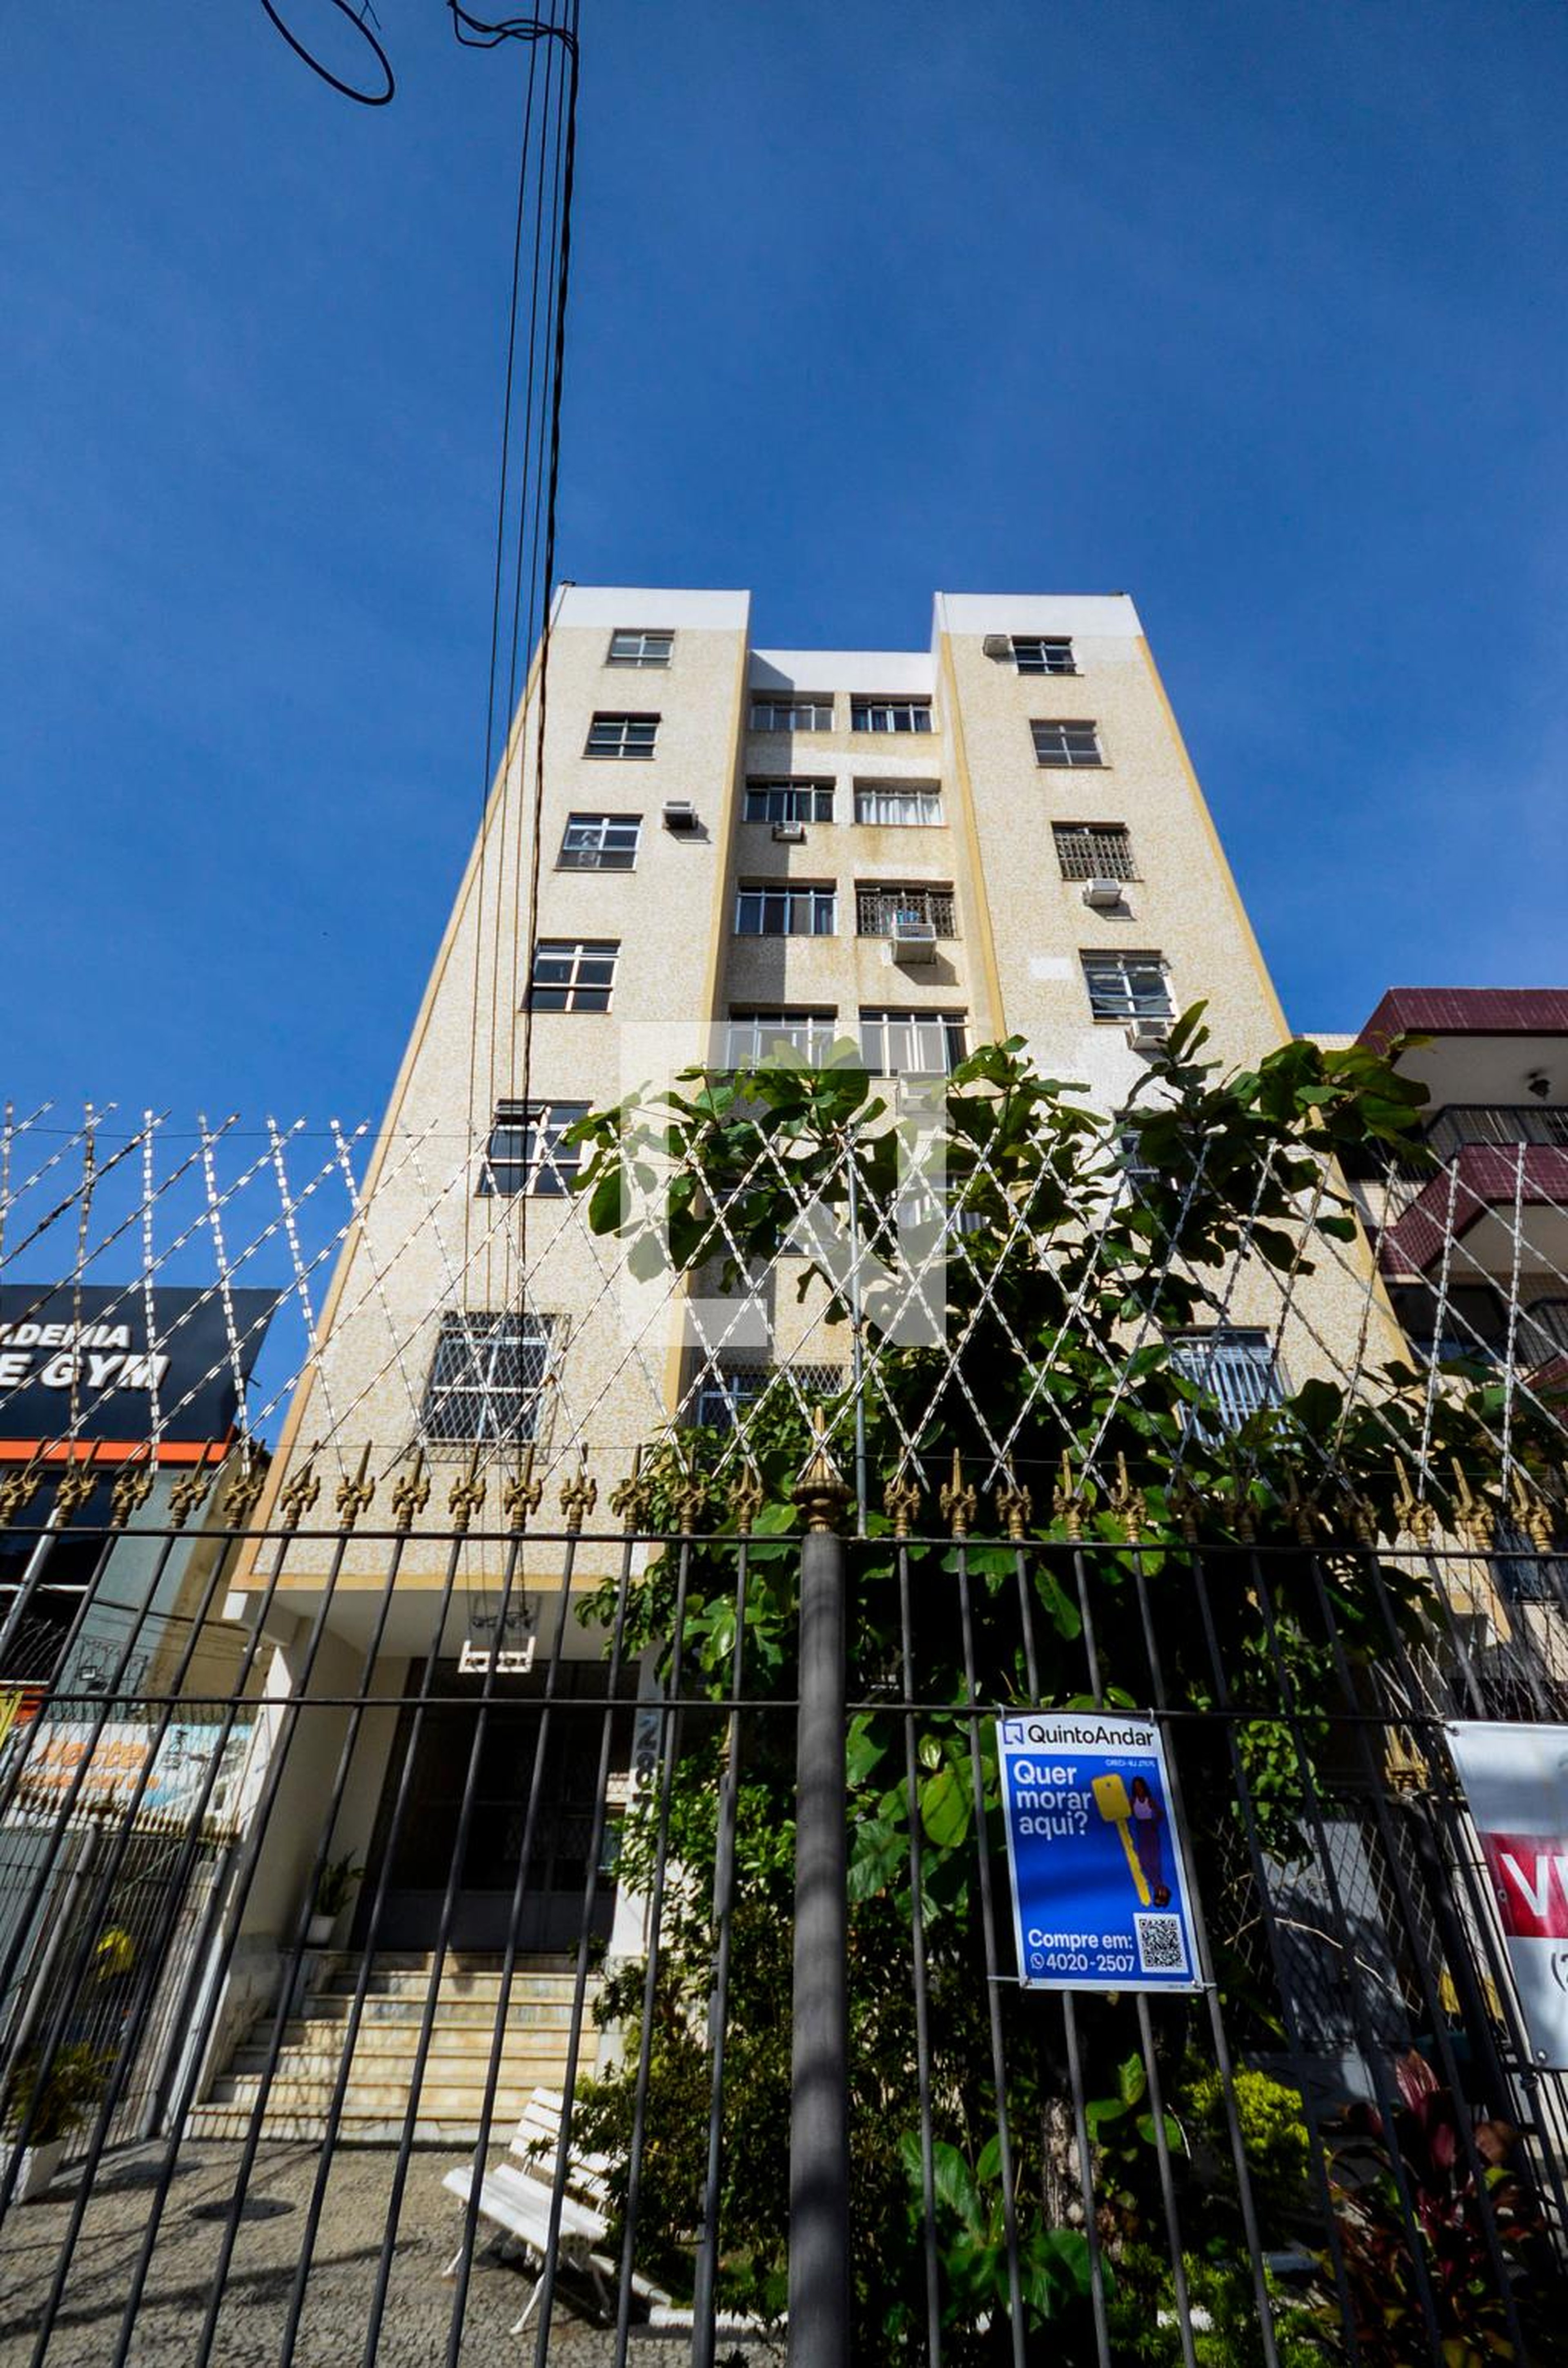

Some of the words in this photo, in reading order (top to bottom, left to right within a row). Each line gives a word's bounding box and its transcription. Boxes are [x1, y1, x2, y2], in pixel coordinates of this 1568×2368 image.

[41, 1353, 170, 1388] GYM
[1028, 1724, 1154, 1747] QuintoAndar
[1013, 1760, 1077, 1785] Quer
[1016, 1789, 1092, 1810] morar
[1020, 1811, 1087, 1840] aqui?
[1028, 1929, 1098, 1951] Compre
[1102, 1936, 1133, 1949] em:
[1046, 1953, 1135, 1972] 4020-2507
